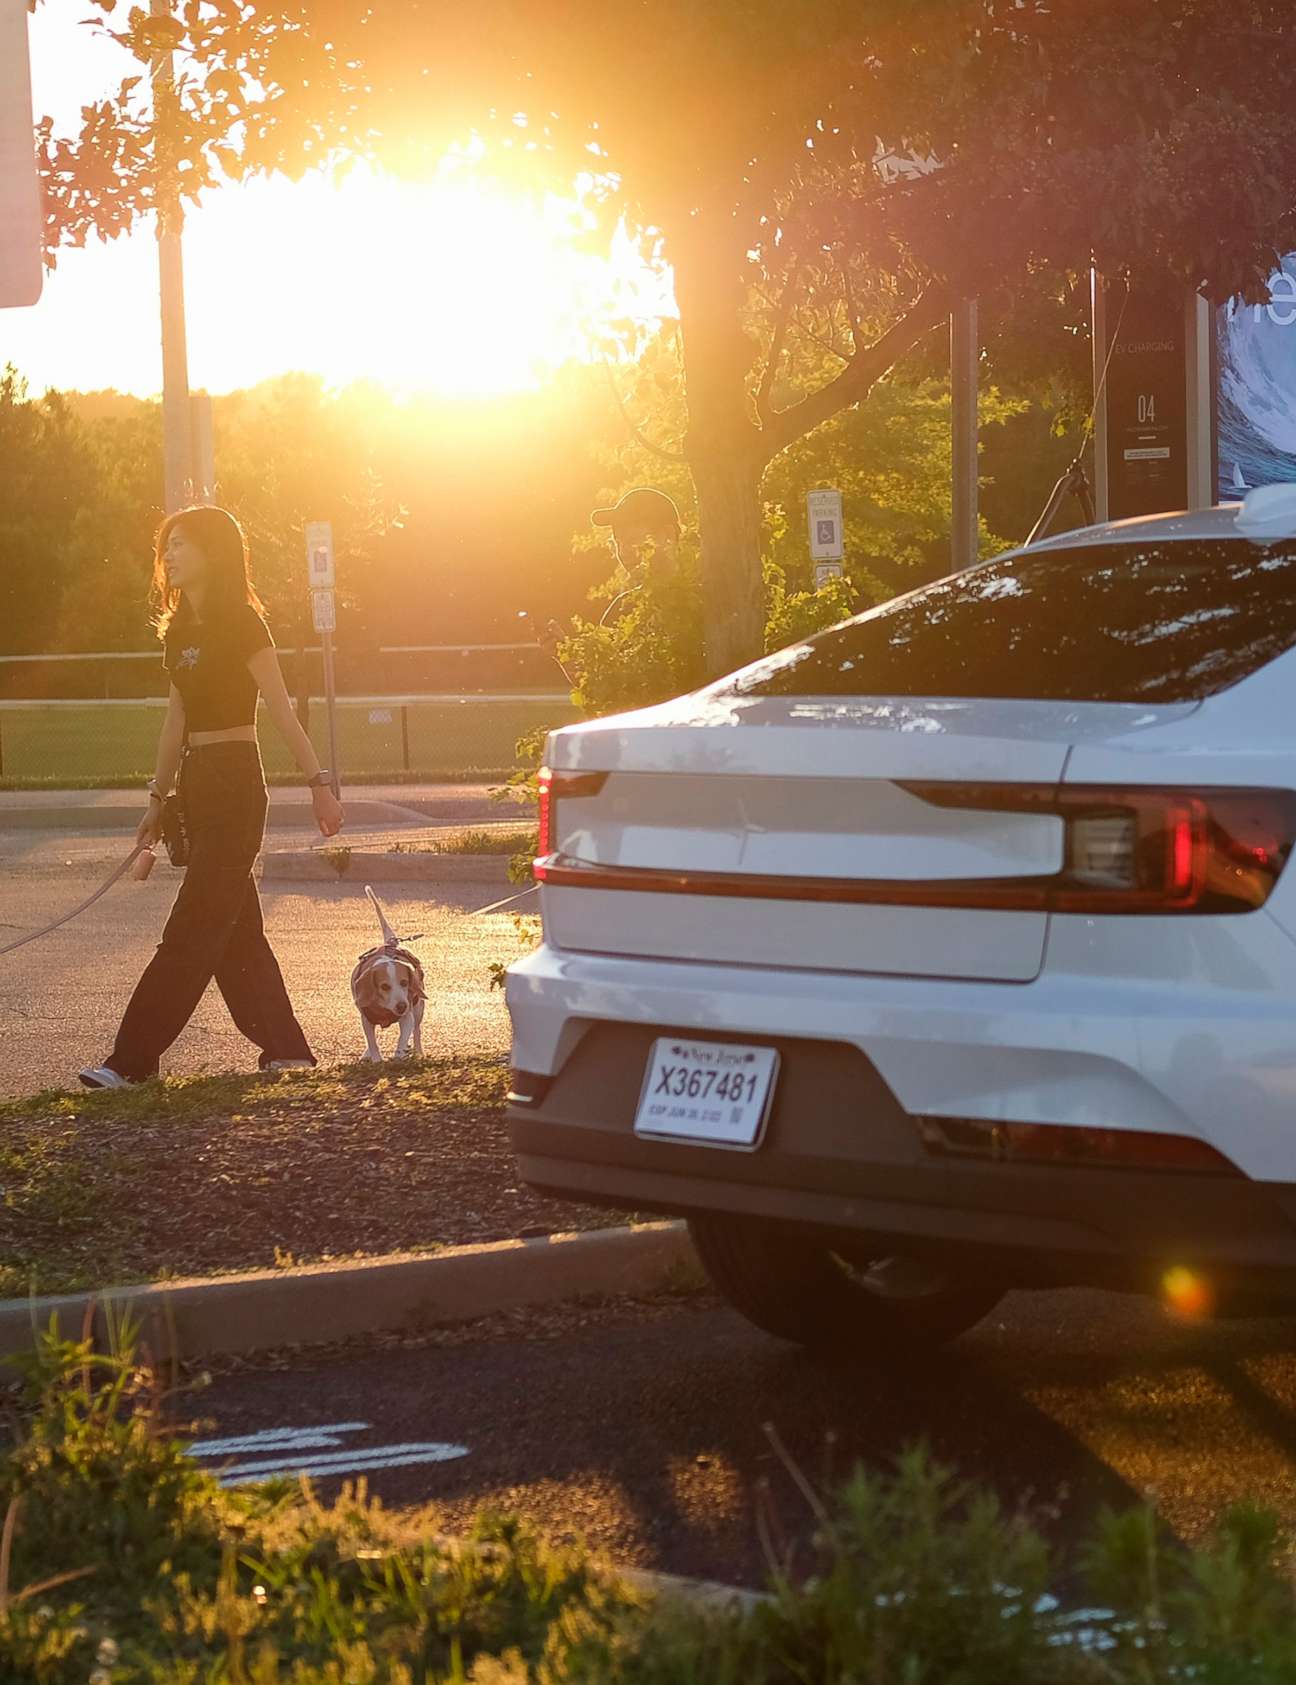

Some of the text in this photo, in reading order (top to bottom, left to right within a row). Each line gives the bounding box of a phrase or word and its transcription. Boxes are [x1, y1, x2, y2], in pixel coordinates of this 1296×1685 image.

[1128, 340, 1175, 353] CHARGING
[1137, 394, 1156, 423] 04
[655, 1065, 758, 1104] X367481
